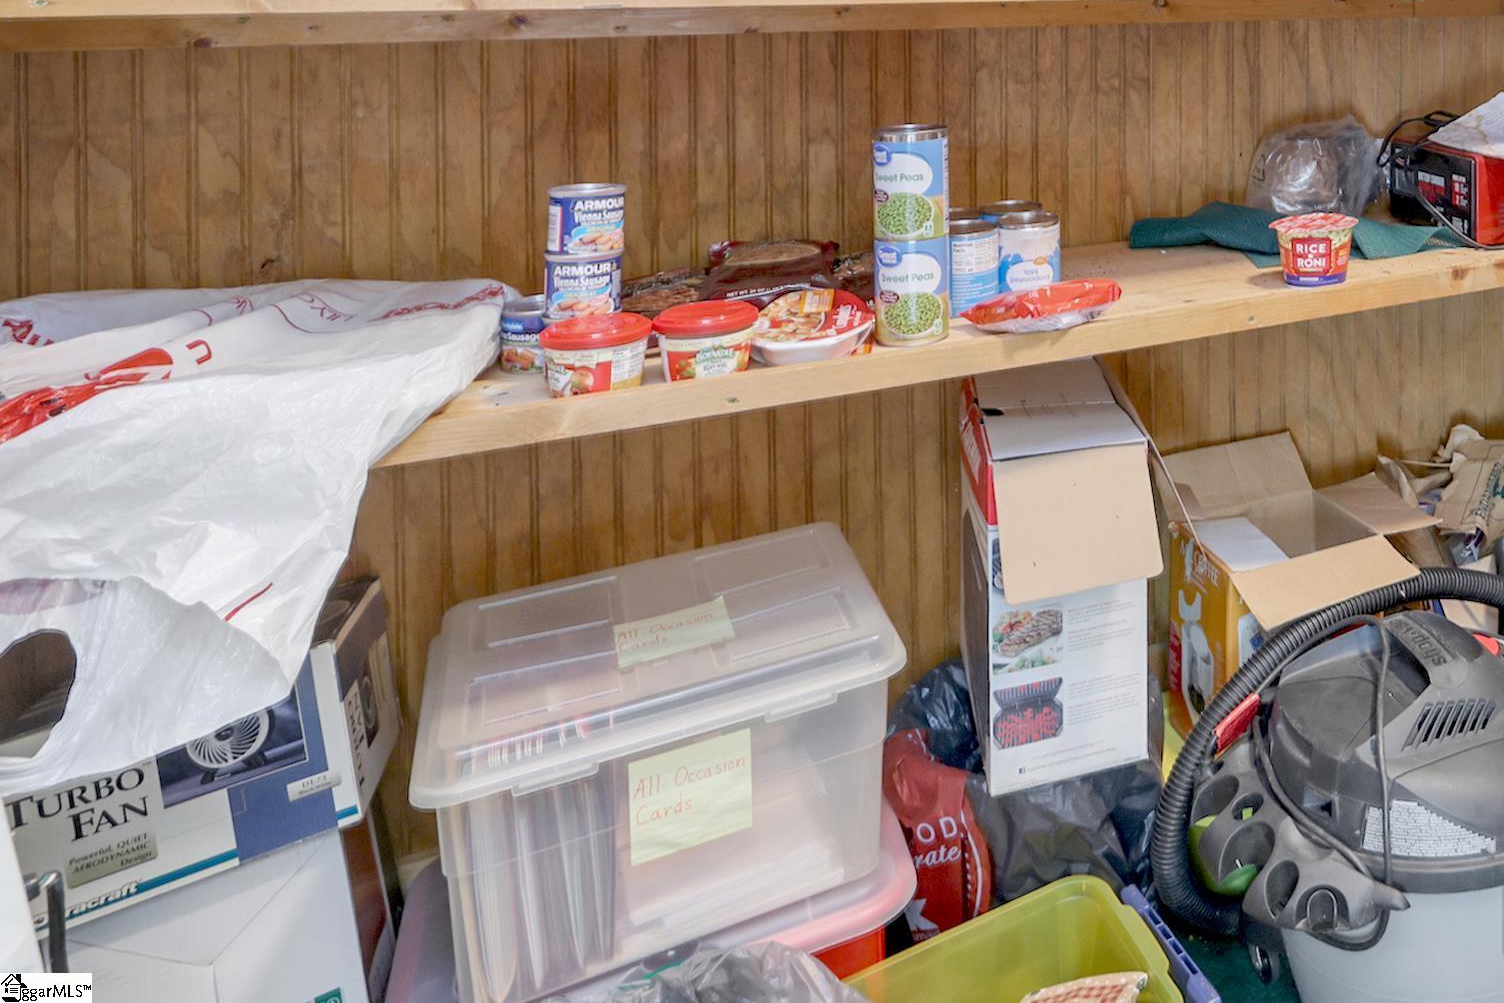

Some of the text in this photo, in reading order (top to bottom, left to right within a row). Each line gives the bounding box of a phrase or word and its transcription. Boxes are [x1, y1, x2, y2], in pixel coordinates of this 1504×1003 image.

[875, 172, 924, 183] Sweet Peas
[1295, 243, 1327, 254] RICE
[553, 263, 611, 276] ARMOUR
[1297, 257, 1327, 268] RONI
[881, 271, 935, 285] Sweet Peas
[650, 611, 716, 637] Occasion
[618, 633, 670, 654] Cards
[673, 755, 749, 789] Occasion
[5, 766, 146, 830] TURBO
[634, 794, 695, 827] Cards
[68, 795, 150, 843] FAN
[915, 815, 959, 844] OD
[67, 831, 149, 868] Powerful, QUIET
[71, 839, 152, 876] AERODYNAMIC
[119, 851, 153, 869] Design
[913, 843, 963, 871] rate
